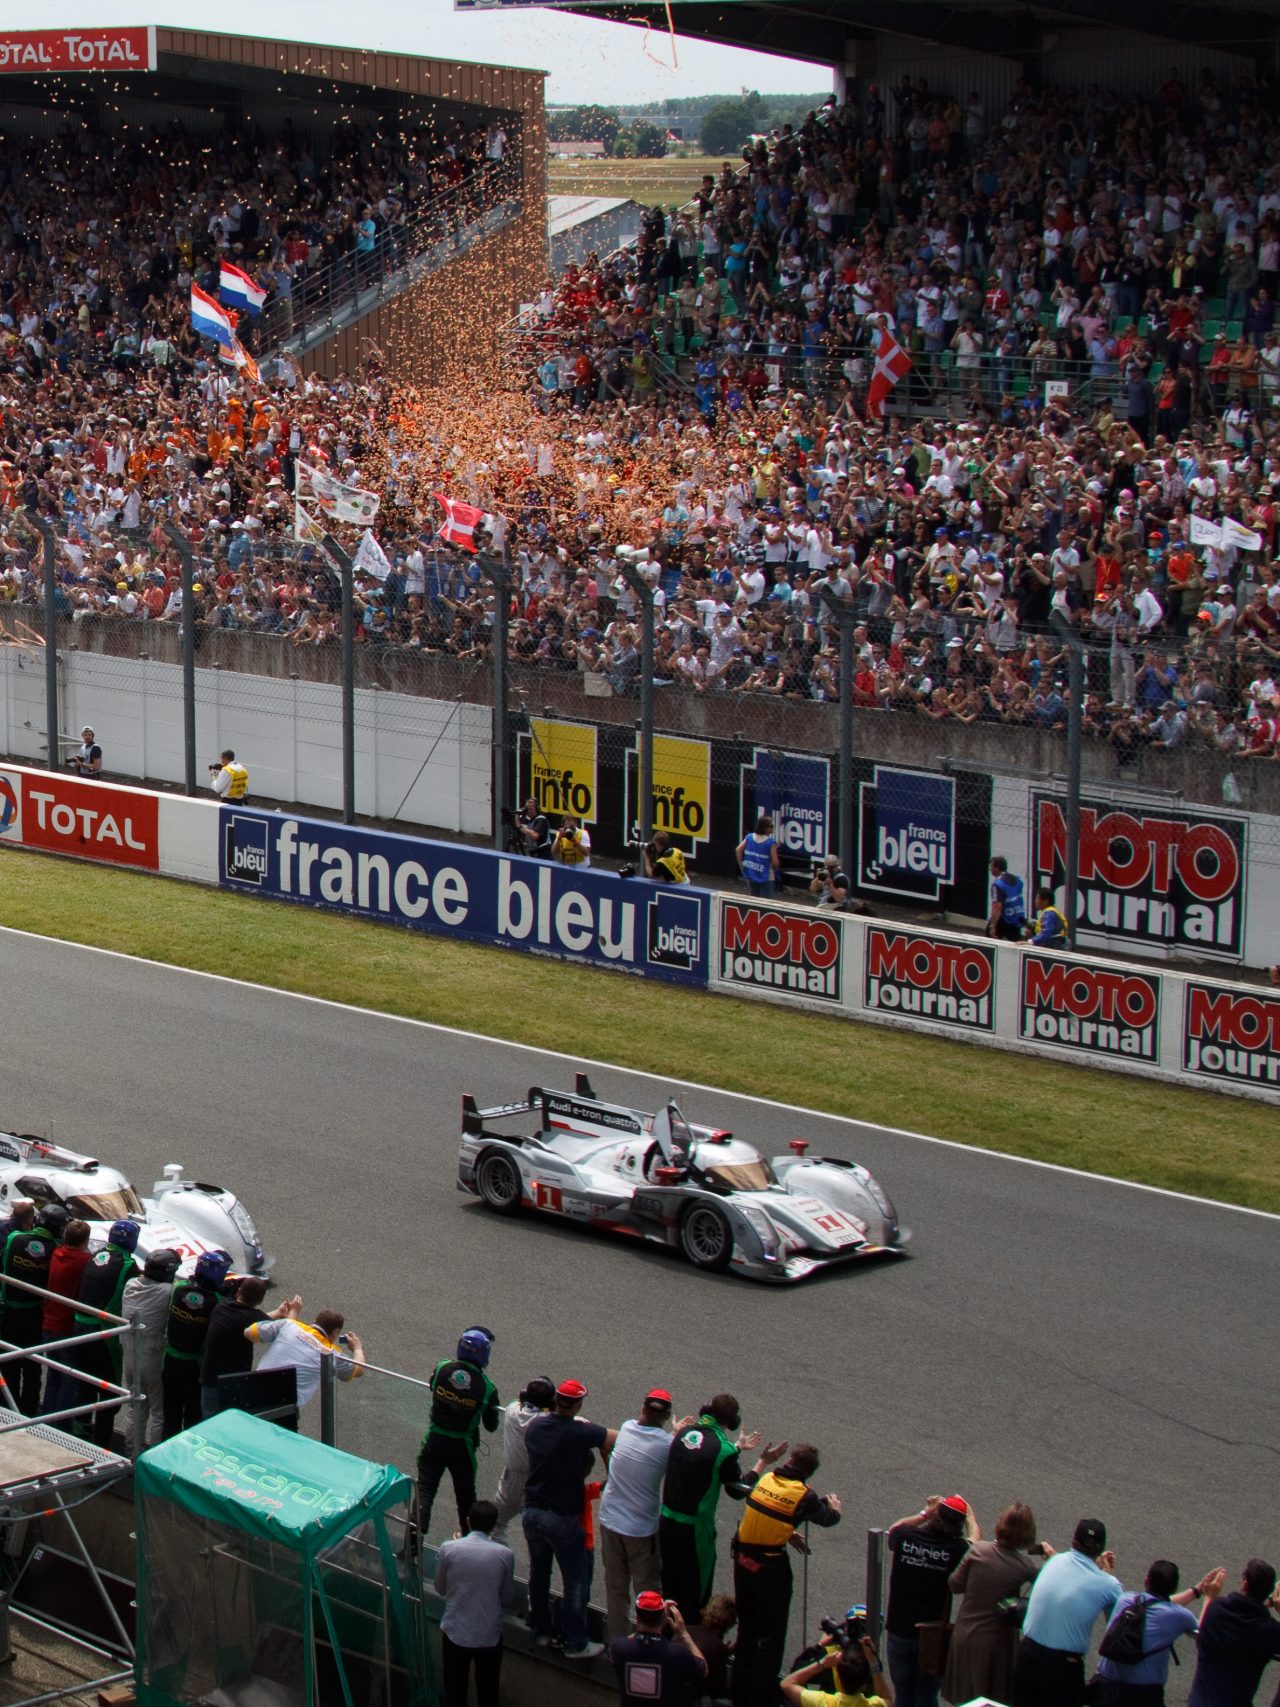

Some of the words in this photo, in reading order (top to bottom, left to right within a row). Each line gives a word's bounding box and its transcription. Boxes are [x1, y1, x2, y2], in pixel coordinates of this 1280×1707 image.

[64, 37, 139, 61] TOTAL
[533, 764, 562, 779] france
[533, 770, 592, 814] info
[30, 791, 147, 852] TOTAL
[652, 787, 704, 833] nfo
[909, 823, 946, 843] france
[234, 846, 265, 872] bleu
[247, 844, 265, 856] france
[879, 826, 946, 875] bleu
[1038, 800, 1238, 901] MOTO
[276, 820, 469, 926] france
[498, 858, 635, 962] bleu
[658, 926, 697, 956] bleu
[674, 924, 697, 937] france
[724, 905, 838, 968] MOTO
[869, 931, 992, 997] MOTO
[1025, 958, 1156, 1028] MOTO
[549, 1099, 571, 1113] Audi
[572, 1105, 601, 1120] e-tron
[603, 1112, 639, 1130] quattro
[542, 1187, 557, 1210] 1
[818, 1216, 845, 1232] 1
[436, 1386, 478, 1408] DOME
[758, 1487, 795, 1505] DUNLOP
[902, 1540, 950, 1561] thiriet
